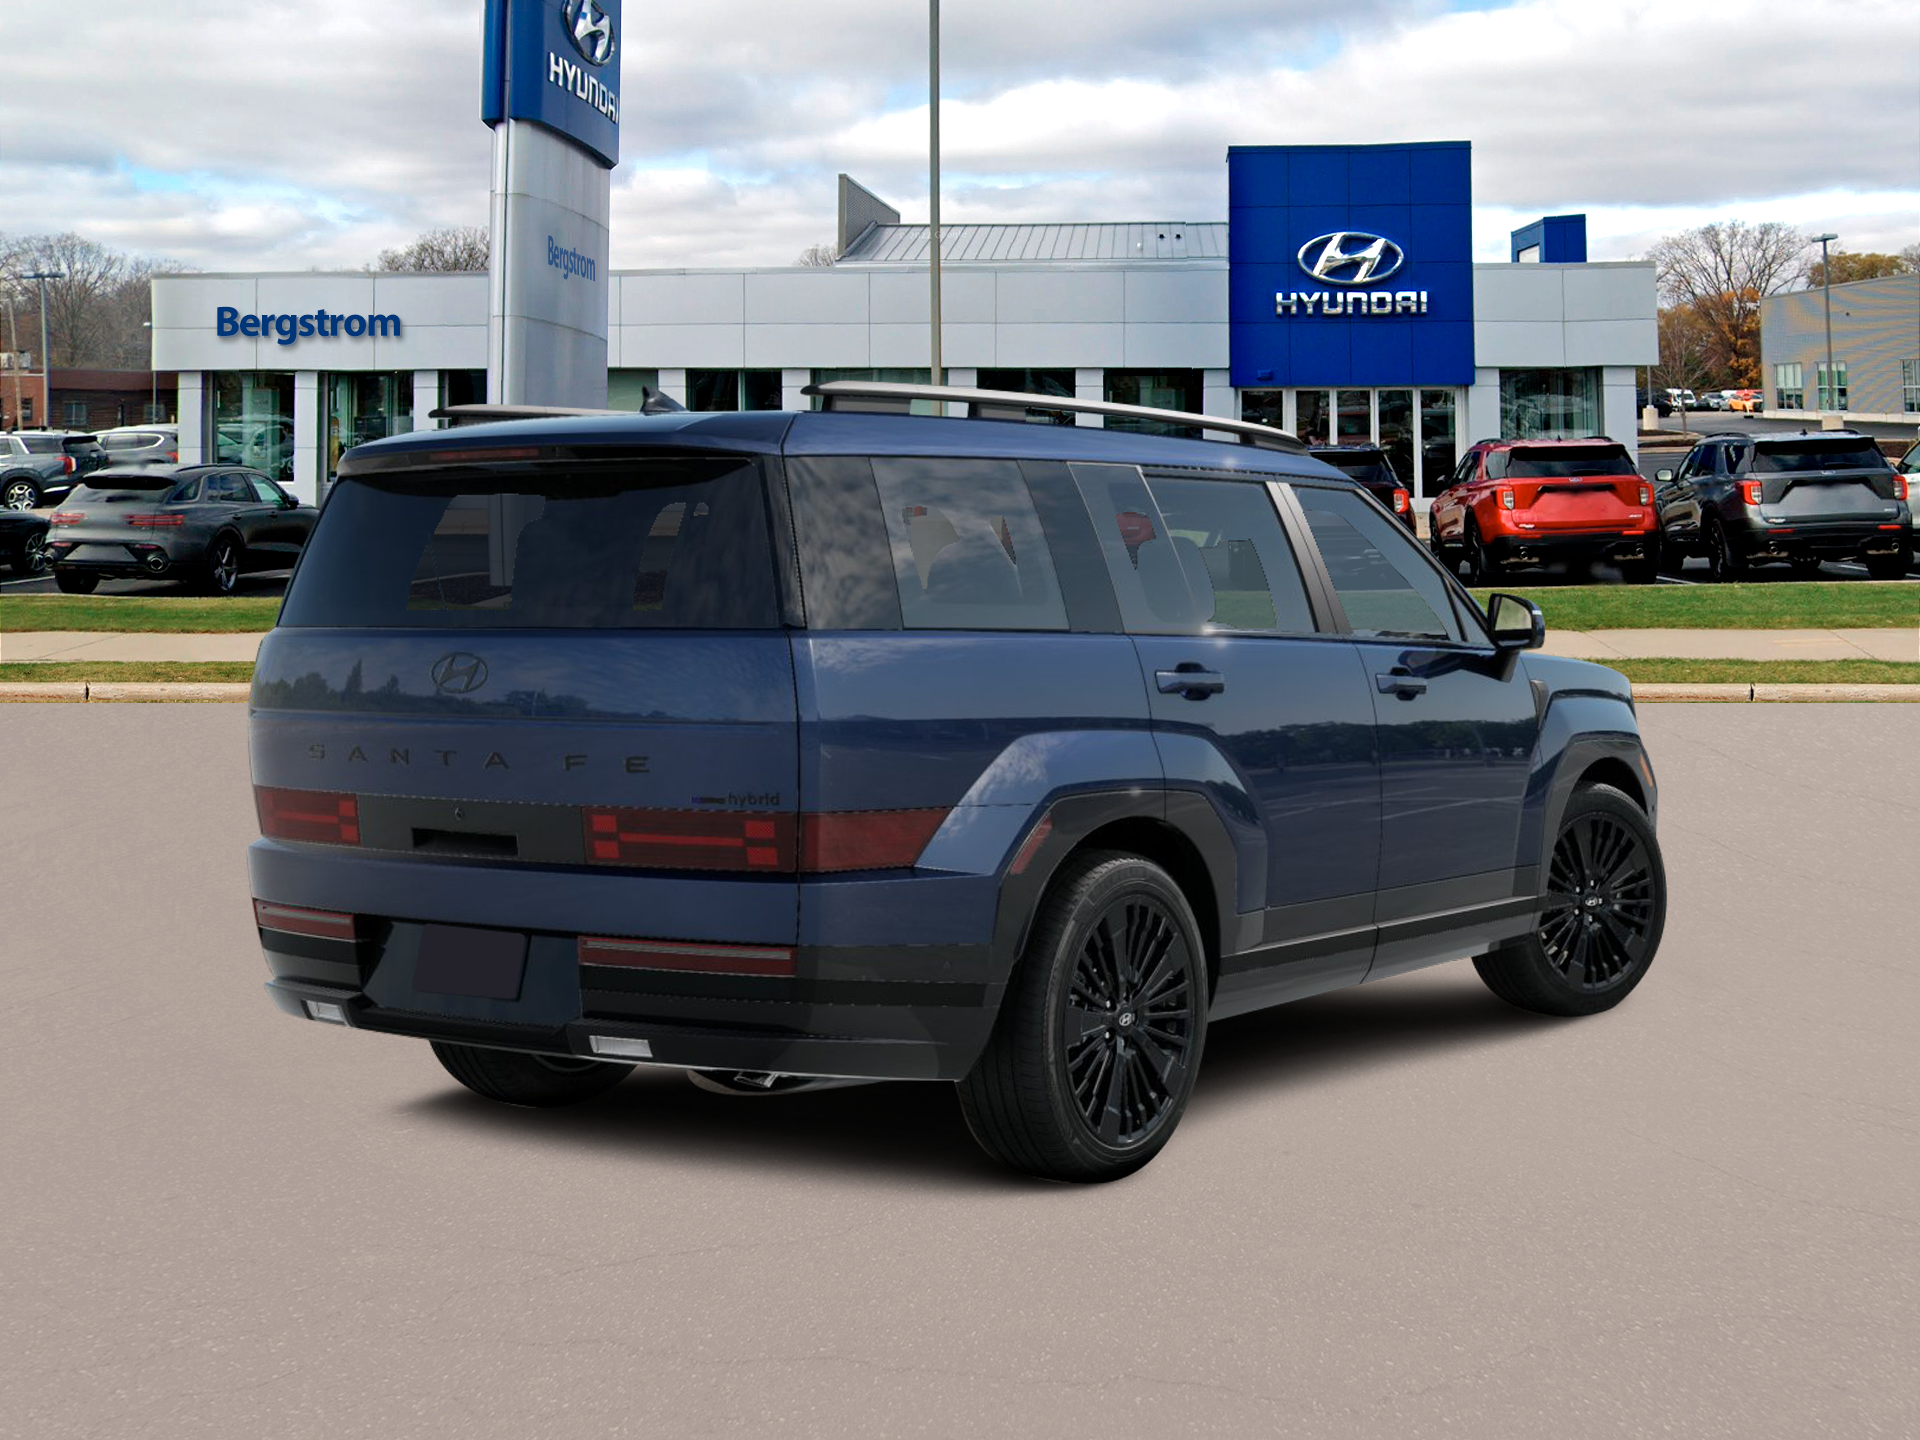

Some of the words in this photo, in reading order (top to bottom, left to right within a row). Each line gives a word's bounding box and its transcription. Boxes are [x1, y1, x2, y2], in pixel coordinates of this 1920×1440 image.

[548, 52, 619, 125] HYUNDAI
[547, 235, 596, 282] Bergstrom
[1275, 290, 1429, 316] HYUNDAI
[216, 306, 401, 346] Bergstrom
[309, 744, 510, 771] SANTA
[563, 754, 650, 774] FE
[727, 792, 781, 808] hybrid
